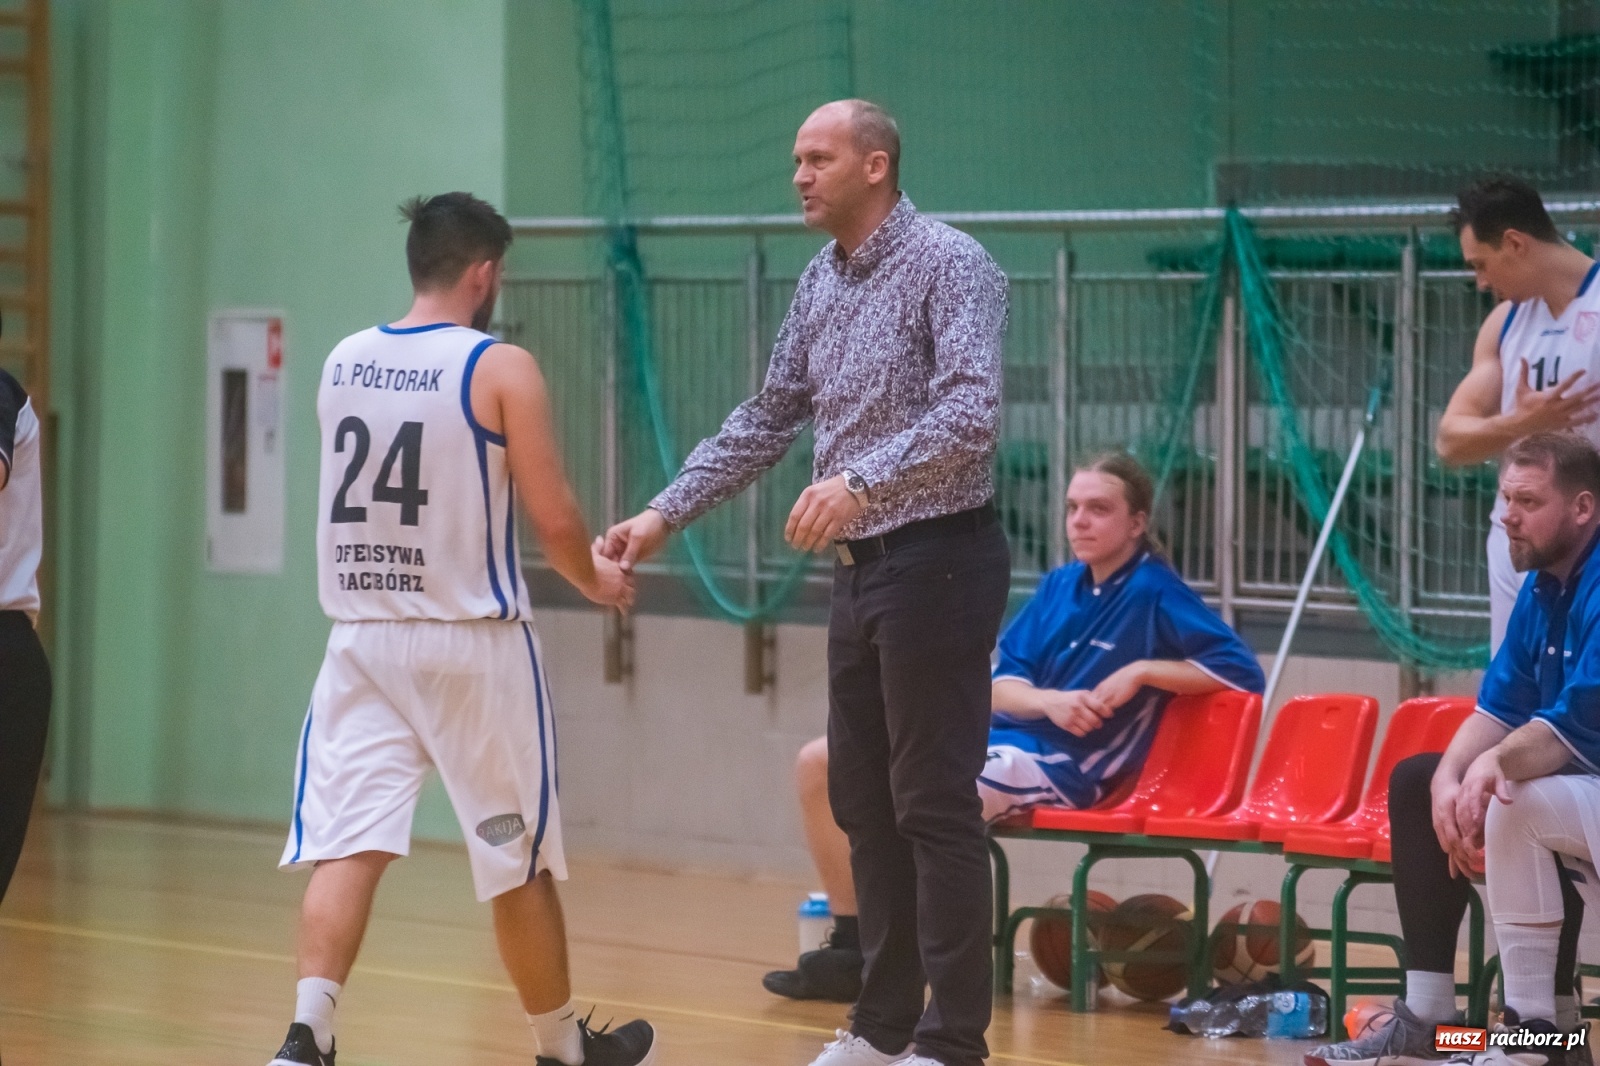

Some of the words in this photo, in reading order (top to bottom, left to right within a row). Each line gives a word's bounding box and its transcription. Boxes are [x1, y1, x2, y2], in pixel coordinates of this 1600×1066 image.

[332, 363, 345, 387] D.
[351, 360, 443, 391] PÓŁTORAK
[330, 415, 428, 526] 24
